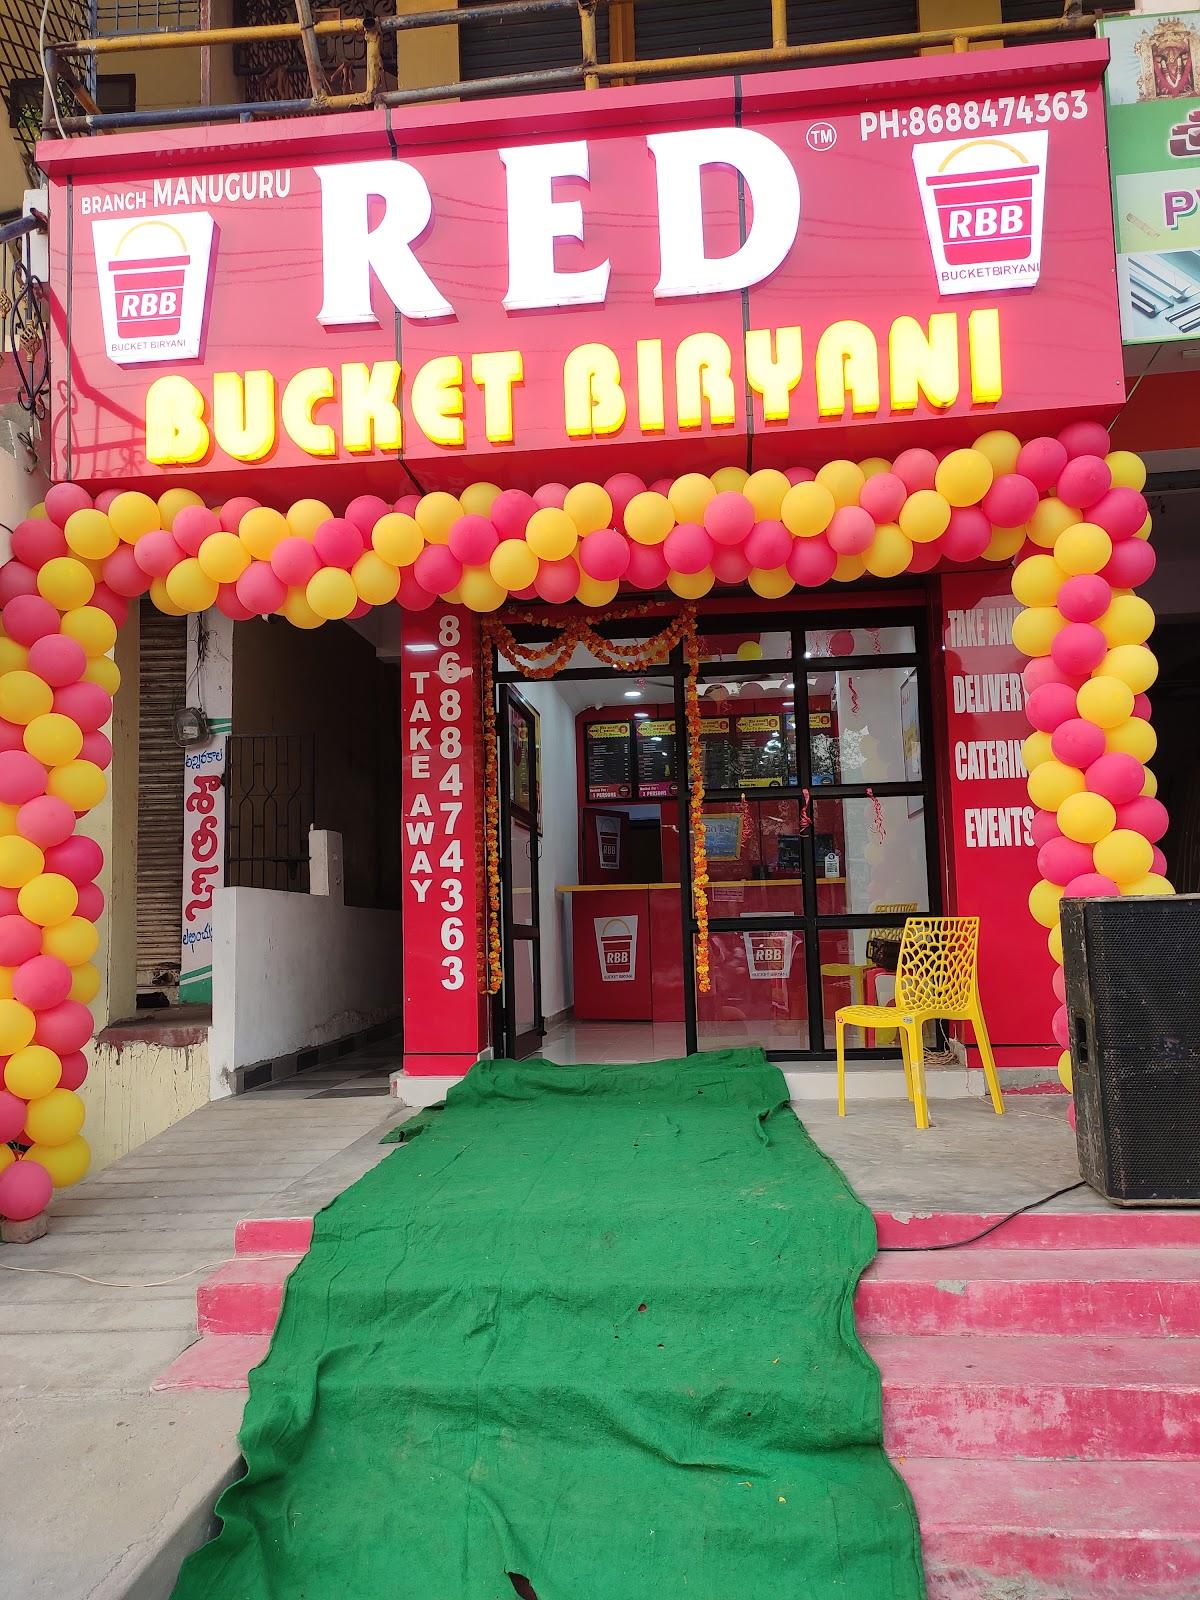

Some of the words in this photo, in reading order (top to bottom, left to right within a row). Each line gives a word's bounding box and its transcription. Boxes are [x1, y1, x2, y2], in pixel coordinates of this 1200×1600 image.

[860, 89, 1088, 141] PH:8688474363
[811, 129, 833, 144] TM
[81, 191, 146, 214] BRANCH
[153, 169, 291, 208] MANUGURU
[313, 127, 801, 327] RED
[949, 205, 1023, 239] RBB
[121, 291, 177, 317] RBB
[111, 341, 148, 351] BUCKET
[150, 339, 186, 348] BIRYANI
[146, 351, 524, 465] BUCKET
[564, 308, 1003, 436] BIRYANI
[948, 609, 985, 648] TAKE
[988, 606, 1025, 646] AW
[409, 672, 432, 779] TAKE
[954, 740, 1028, 781] CATERIN
[438, 615, 465, 990] 8688474363
[406, 793, 434, 903] AWAY
[964, 806, 1035, 848] EVENTS
[606, 951, 629, 964] RBB
[755, 949, 782, 961] RBB
